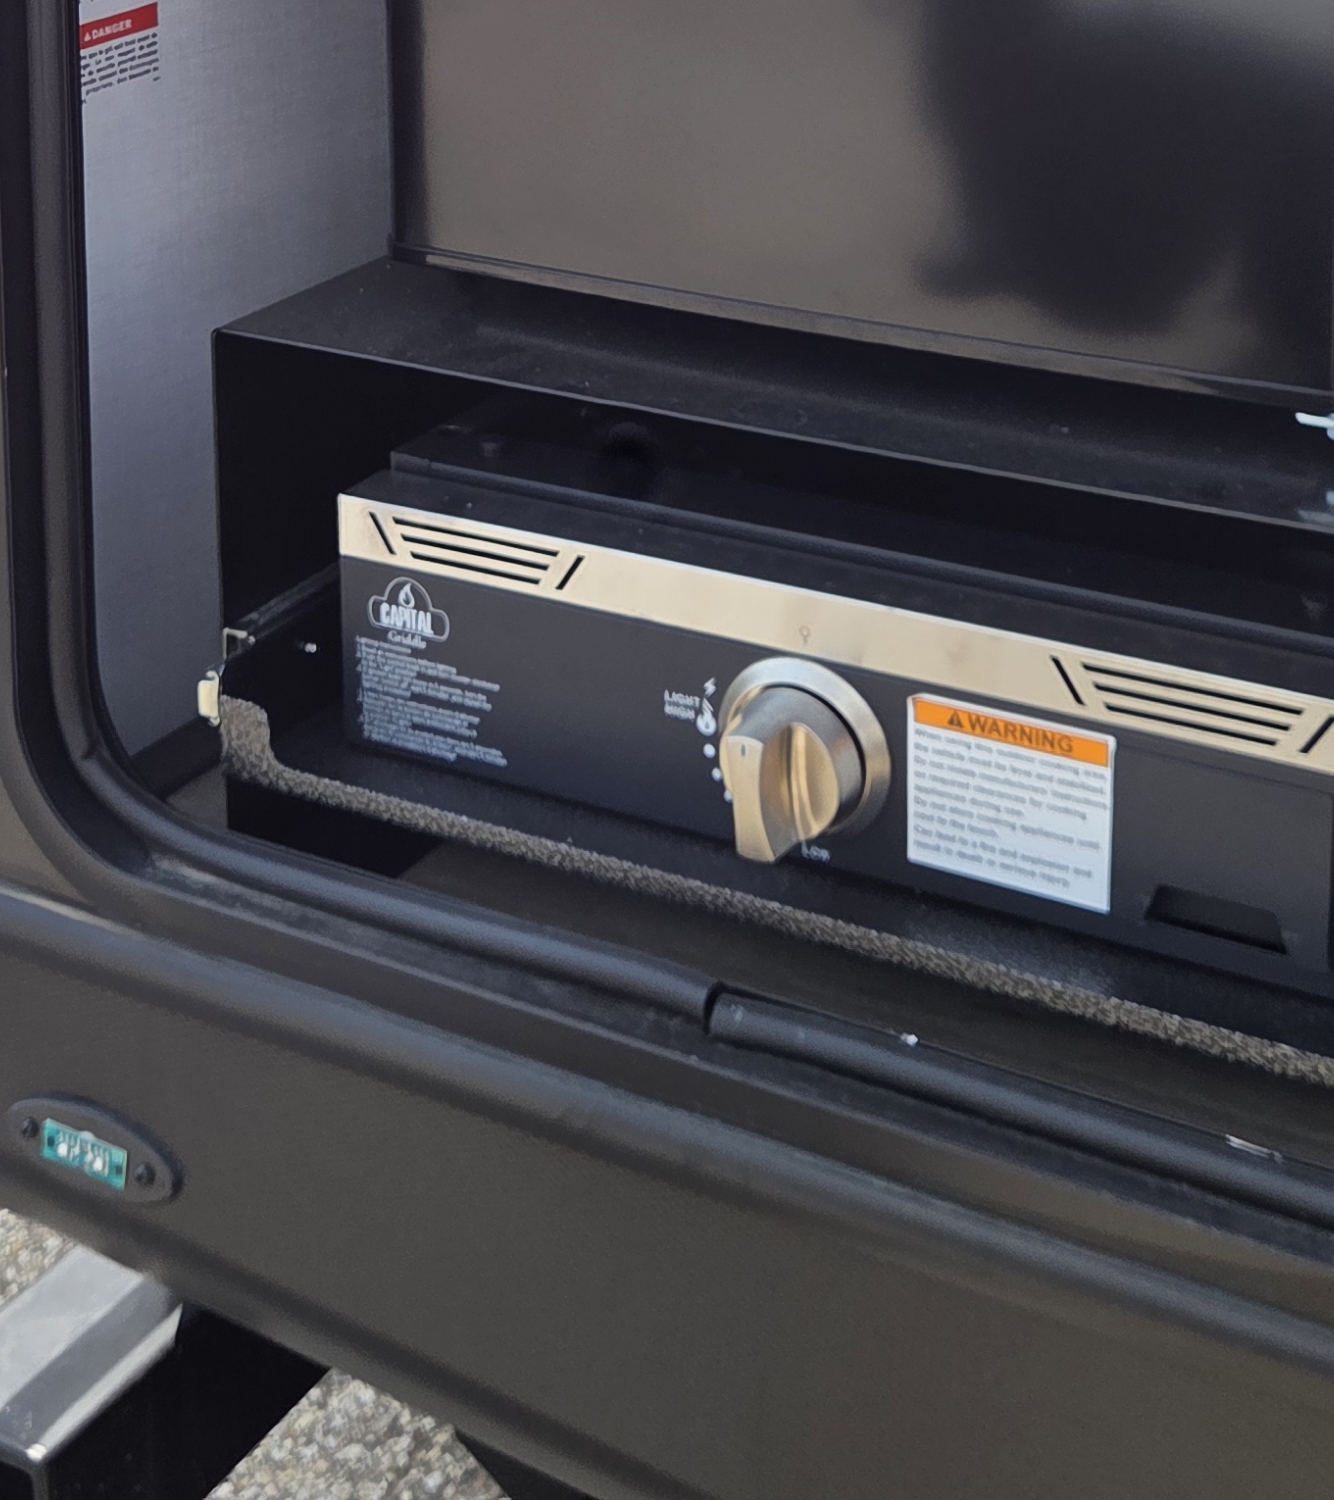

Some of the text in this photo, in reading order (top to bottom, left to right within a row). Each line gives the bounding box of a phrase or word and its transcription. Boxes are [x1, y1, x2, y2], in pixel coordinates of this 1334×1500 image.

[92, 19, 132, 40] DANGER
[379, 602, 435, 636] CAPITAL
[387, 630, 427, 650] Griddle
[664, 689, 701, 708] LIGHT
[967, 712, 1074, 754] WARNING
